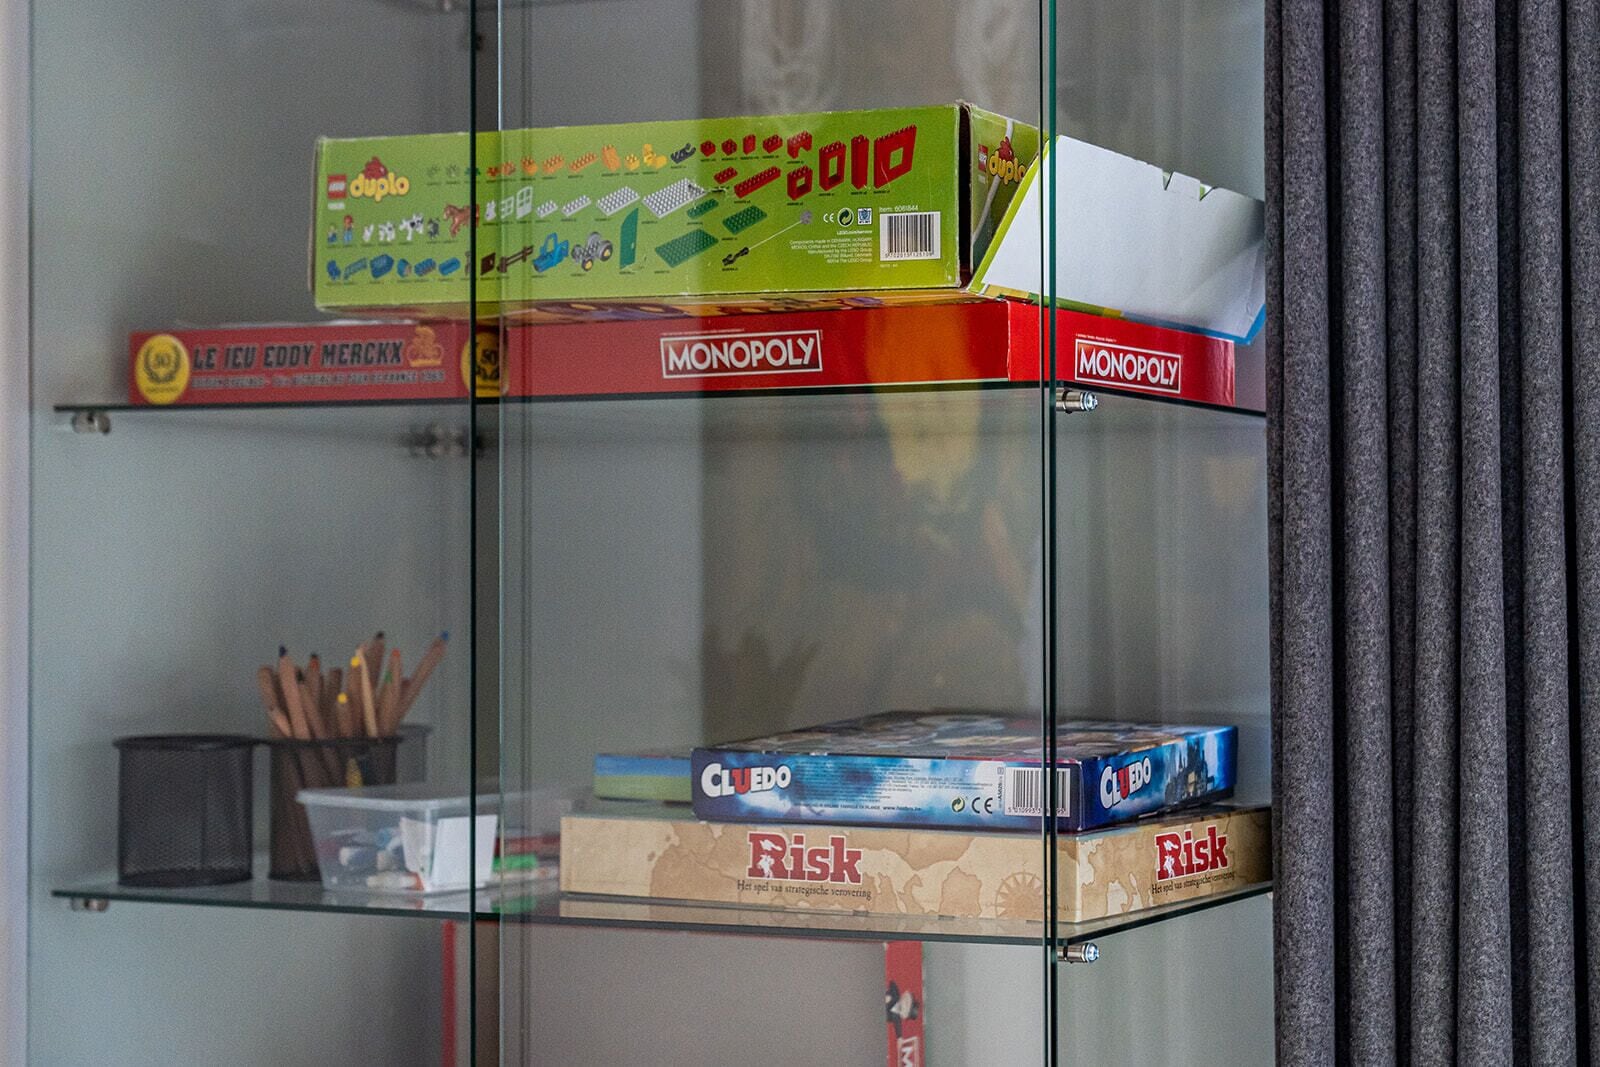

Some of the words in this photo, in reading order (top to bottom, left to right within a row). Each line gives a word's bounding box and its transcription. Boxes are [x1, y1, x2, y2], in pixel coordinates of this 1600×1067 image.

[350, 172, 410, 202] duplo
[192, 348, 217, 370] LE
[263, 344, 313, 367] EDDY
[320, 340, 403, 365] MERCKX
[668, 337, 814, 371] MONOPOLY
[1079, 347, 1178, 386] MONOPOLY
[701, 763, 792, 798] CLUEDO
[1100, 756, 1151, 809] CLUEDO
[747, 832, 863, 884] Risk
[1155, 825, 1228, 881] Risk
[737, 880, 751, 892] Het
[753, 881, 769, 895] spel
[771, 884, 783, 892] van
[785, 884, 829, 898] strategische
[831, 888, 872, 901] verovering
